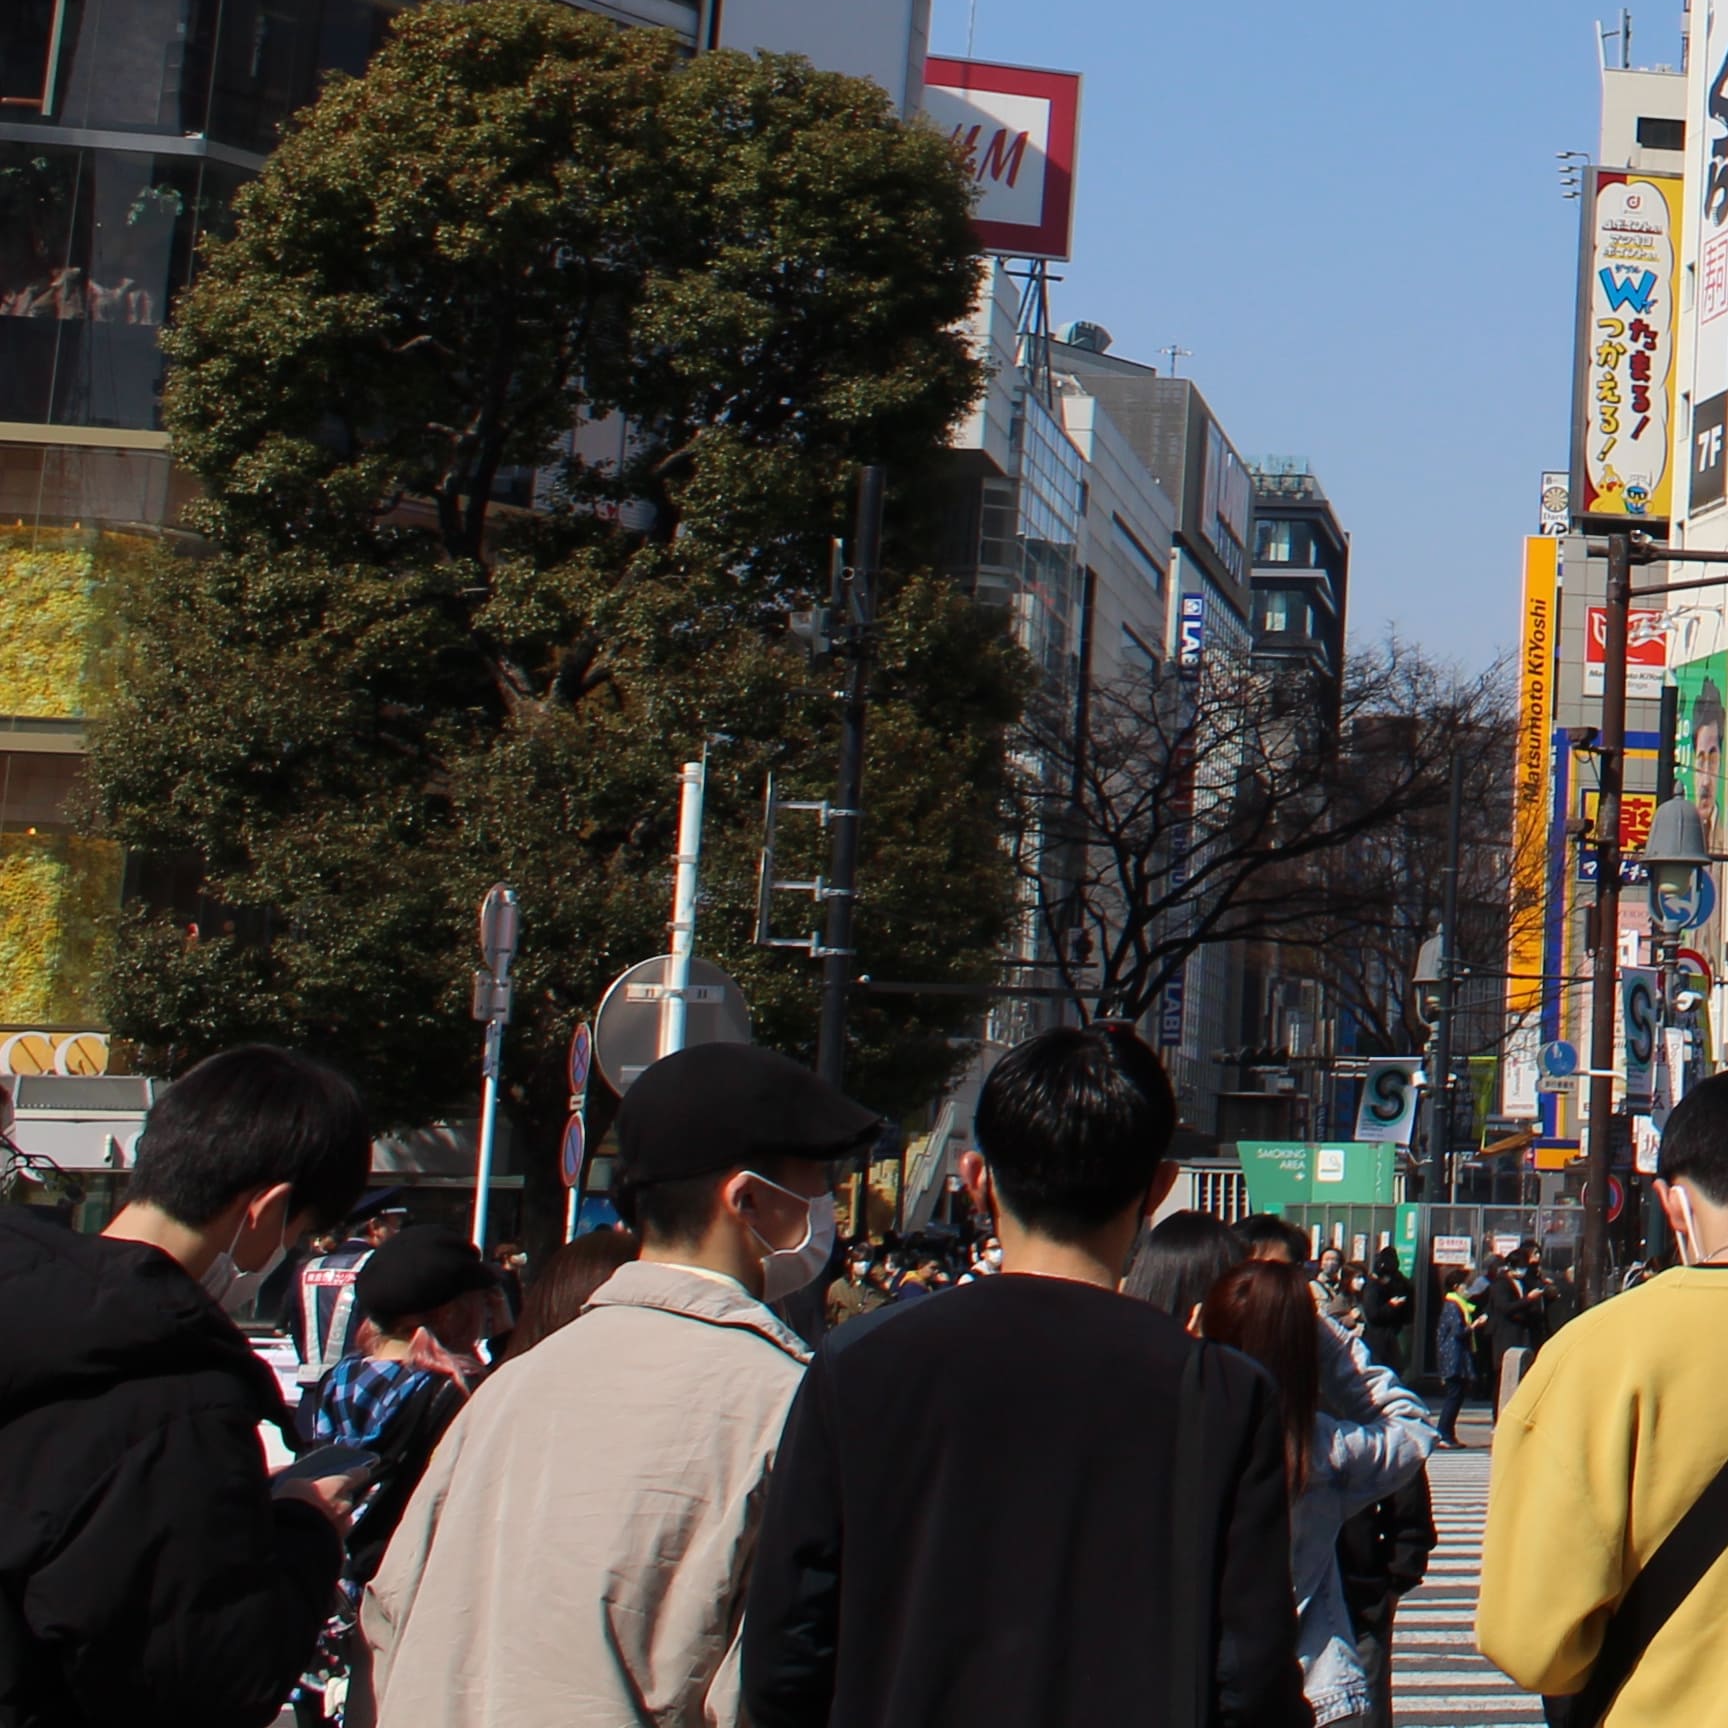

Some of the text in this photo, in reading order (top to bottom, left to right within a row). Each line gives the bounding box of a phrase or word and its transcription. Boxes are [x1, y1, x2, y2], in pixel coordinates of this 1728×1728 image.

[1697, 424, 1724, 474] 7F
[1256, 1148, 1307, 1161] SMOKING
[1279, 1160, 1306, 1171] AREA
